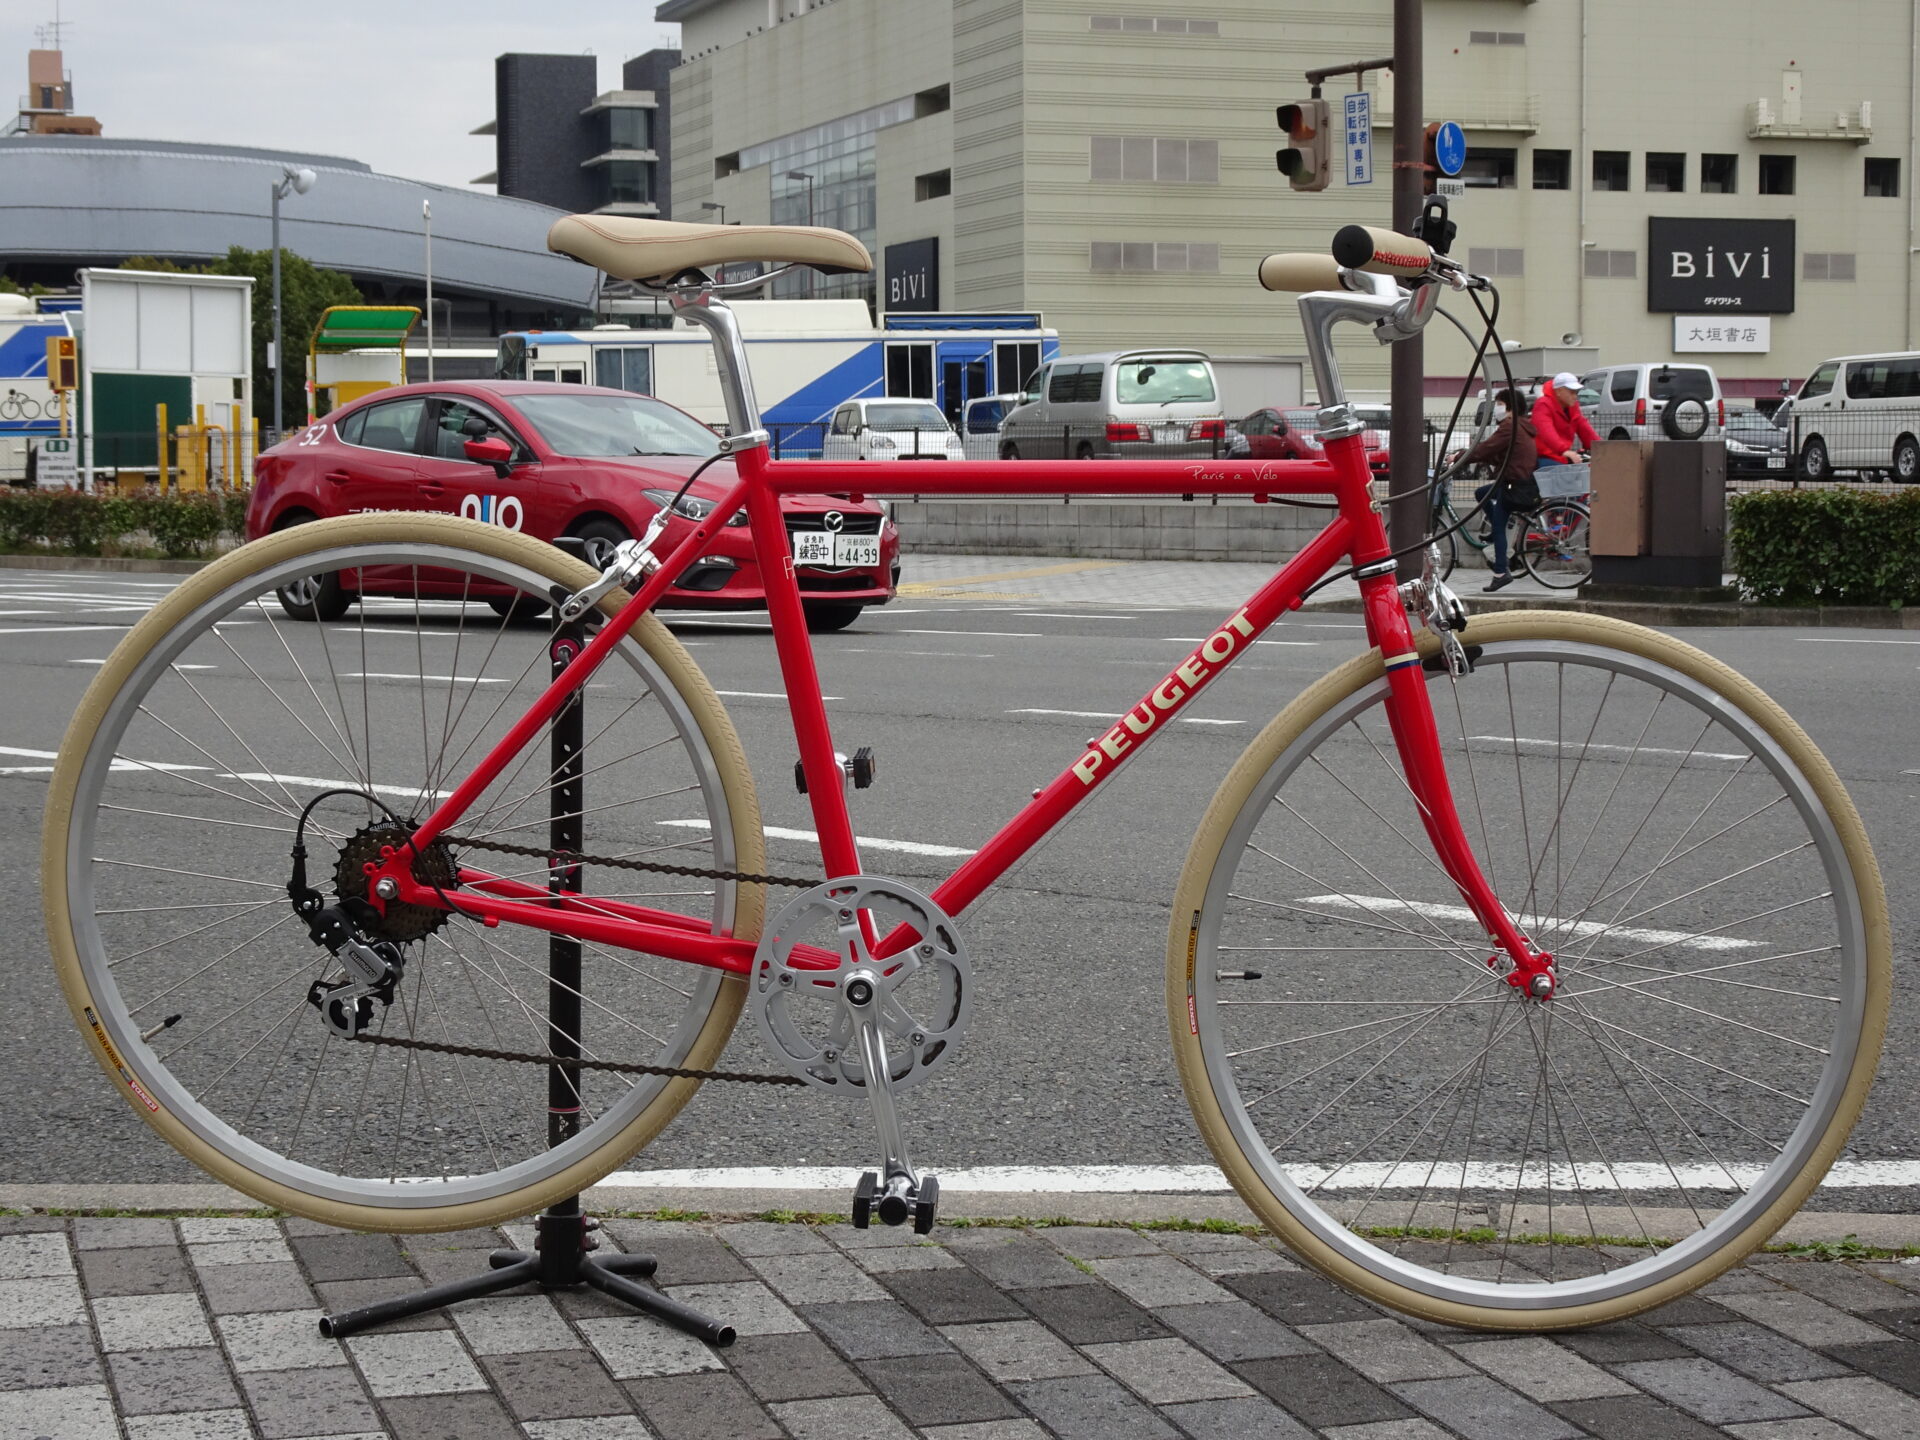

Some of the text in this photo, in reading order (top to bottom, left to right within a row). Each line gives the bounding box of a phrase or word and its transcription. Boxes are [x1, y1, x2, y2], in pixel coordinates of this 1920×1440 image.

[1347, 100, 1357, 146] 自転車
[1358, 98, 1367, 145] 歩行者
[1354, 148, 1364, 180] 専用
[1704, 297, 1742, 305] ダイワリース
[1688, 327, 1758, 342] 大垣書店
[299, 424, 328, 447] 52
[1183, 465, 1225, 480] Paris
[799, 544, 829, 560] 練習中
[845, 548, 878, 564] 44-99
[1072, 606, 1255, 786] PEUGEOT
[130, 1081, 158, 1110] KENDA
